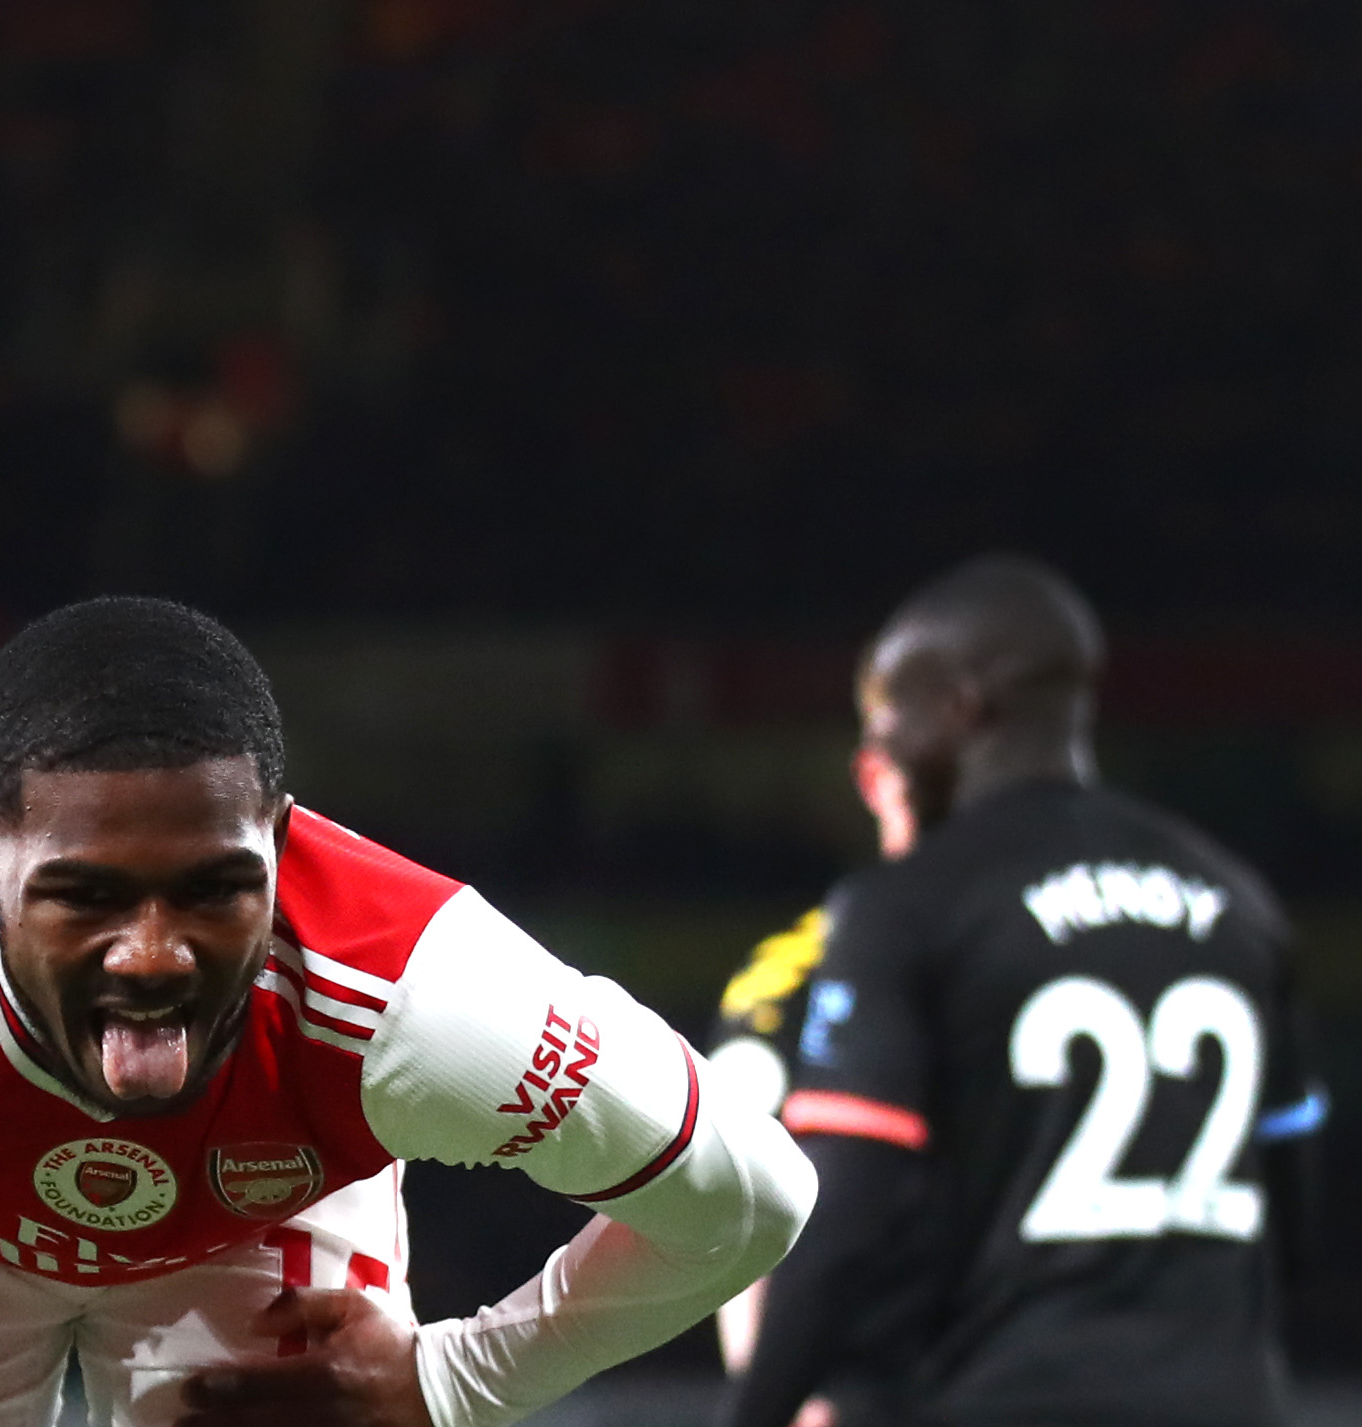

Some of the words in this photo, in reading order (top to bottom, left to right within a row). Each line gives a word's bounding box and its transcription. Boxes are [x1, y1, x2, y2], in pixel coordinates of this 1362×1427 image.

[496, 1004, 571, 1114] VISIT
[1010, 974, 1263, 1241] 22
[43, 1148, 76, 1171] THE
[85, 1142, 169, 1187] ARSENAL
[84, 1166, 130, 1180] Arsenal
[221, 1156, 304, 1173] Arsenal
[40, 1181, 165, 1227] FOUNDATION
